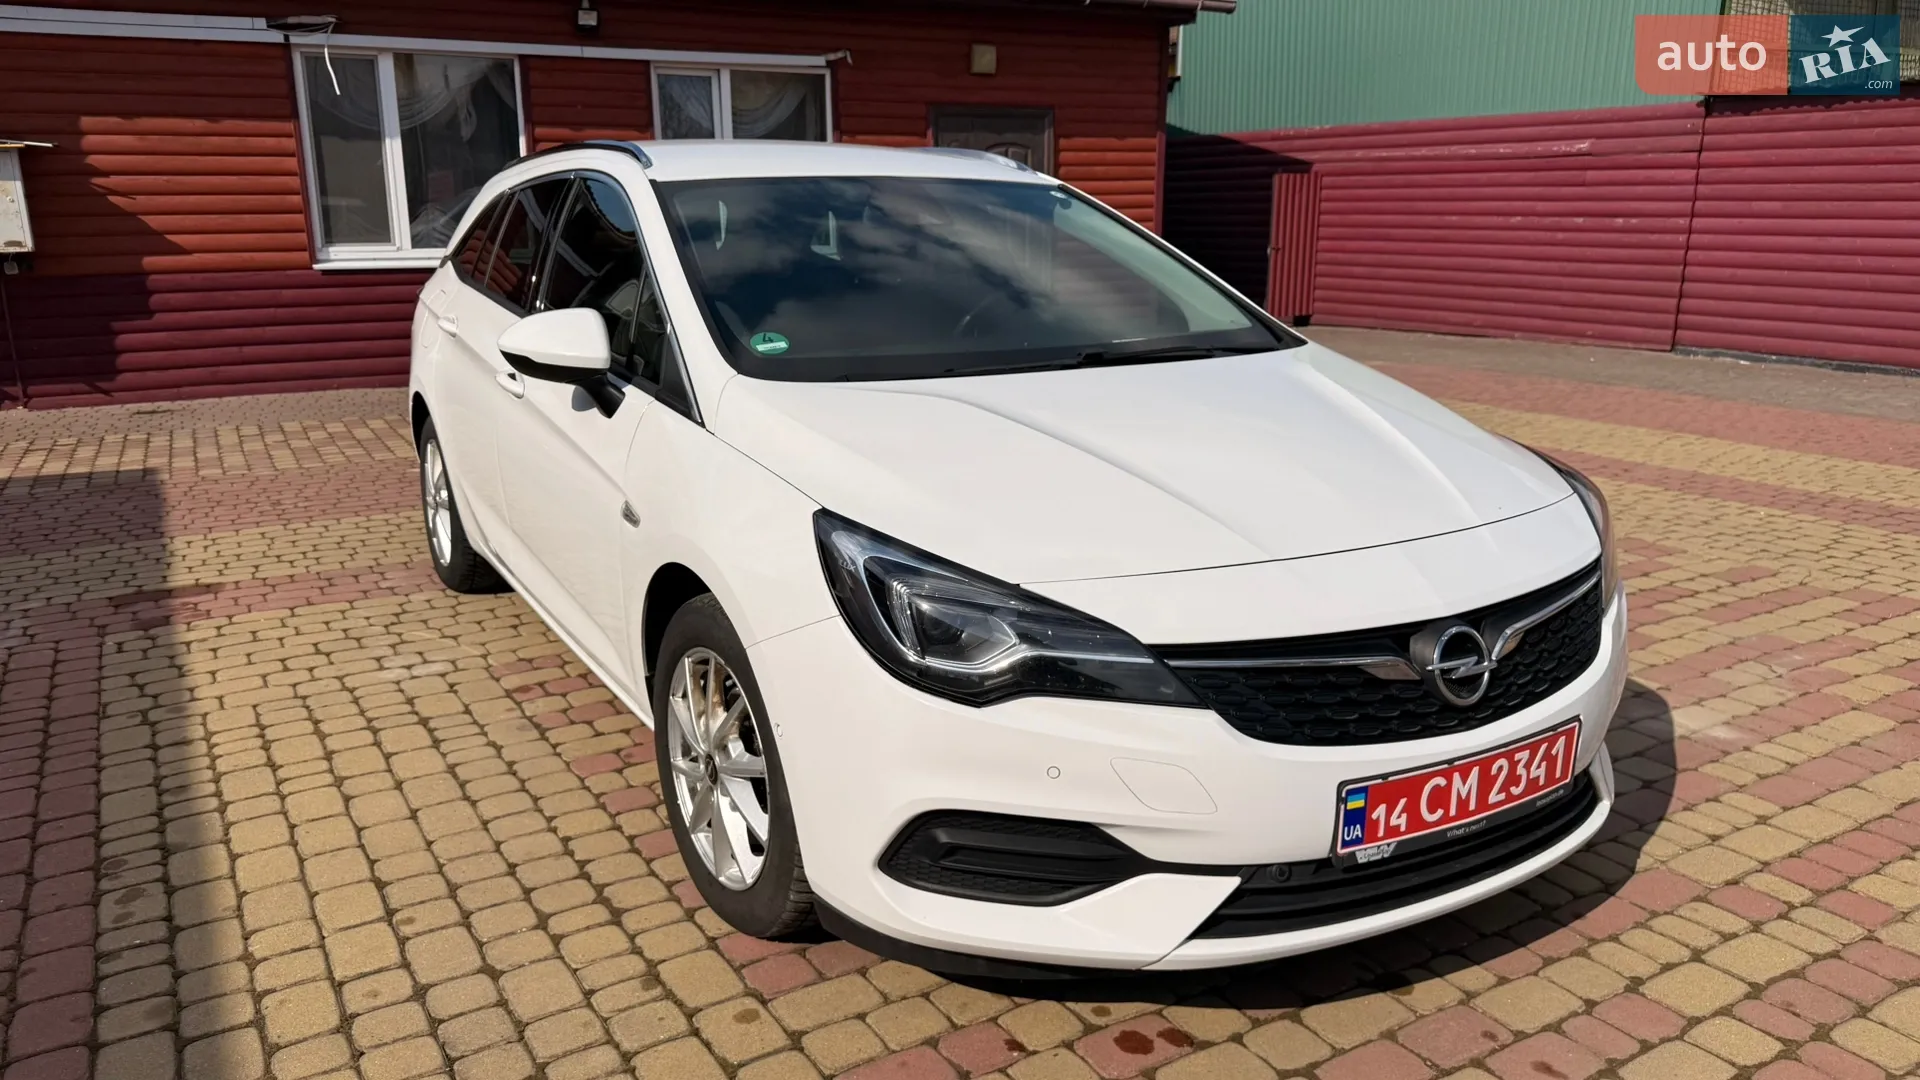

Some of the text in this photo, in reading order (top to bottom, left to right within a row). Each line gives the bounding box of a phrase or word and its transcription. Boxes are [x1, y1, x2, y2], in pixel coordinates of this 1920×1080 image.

[763, 332, 774, 343] 4
[1371, 735, 1566, 838] 14 CM 2341
[1344, 824, 1363, 840] UA
